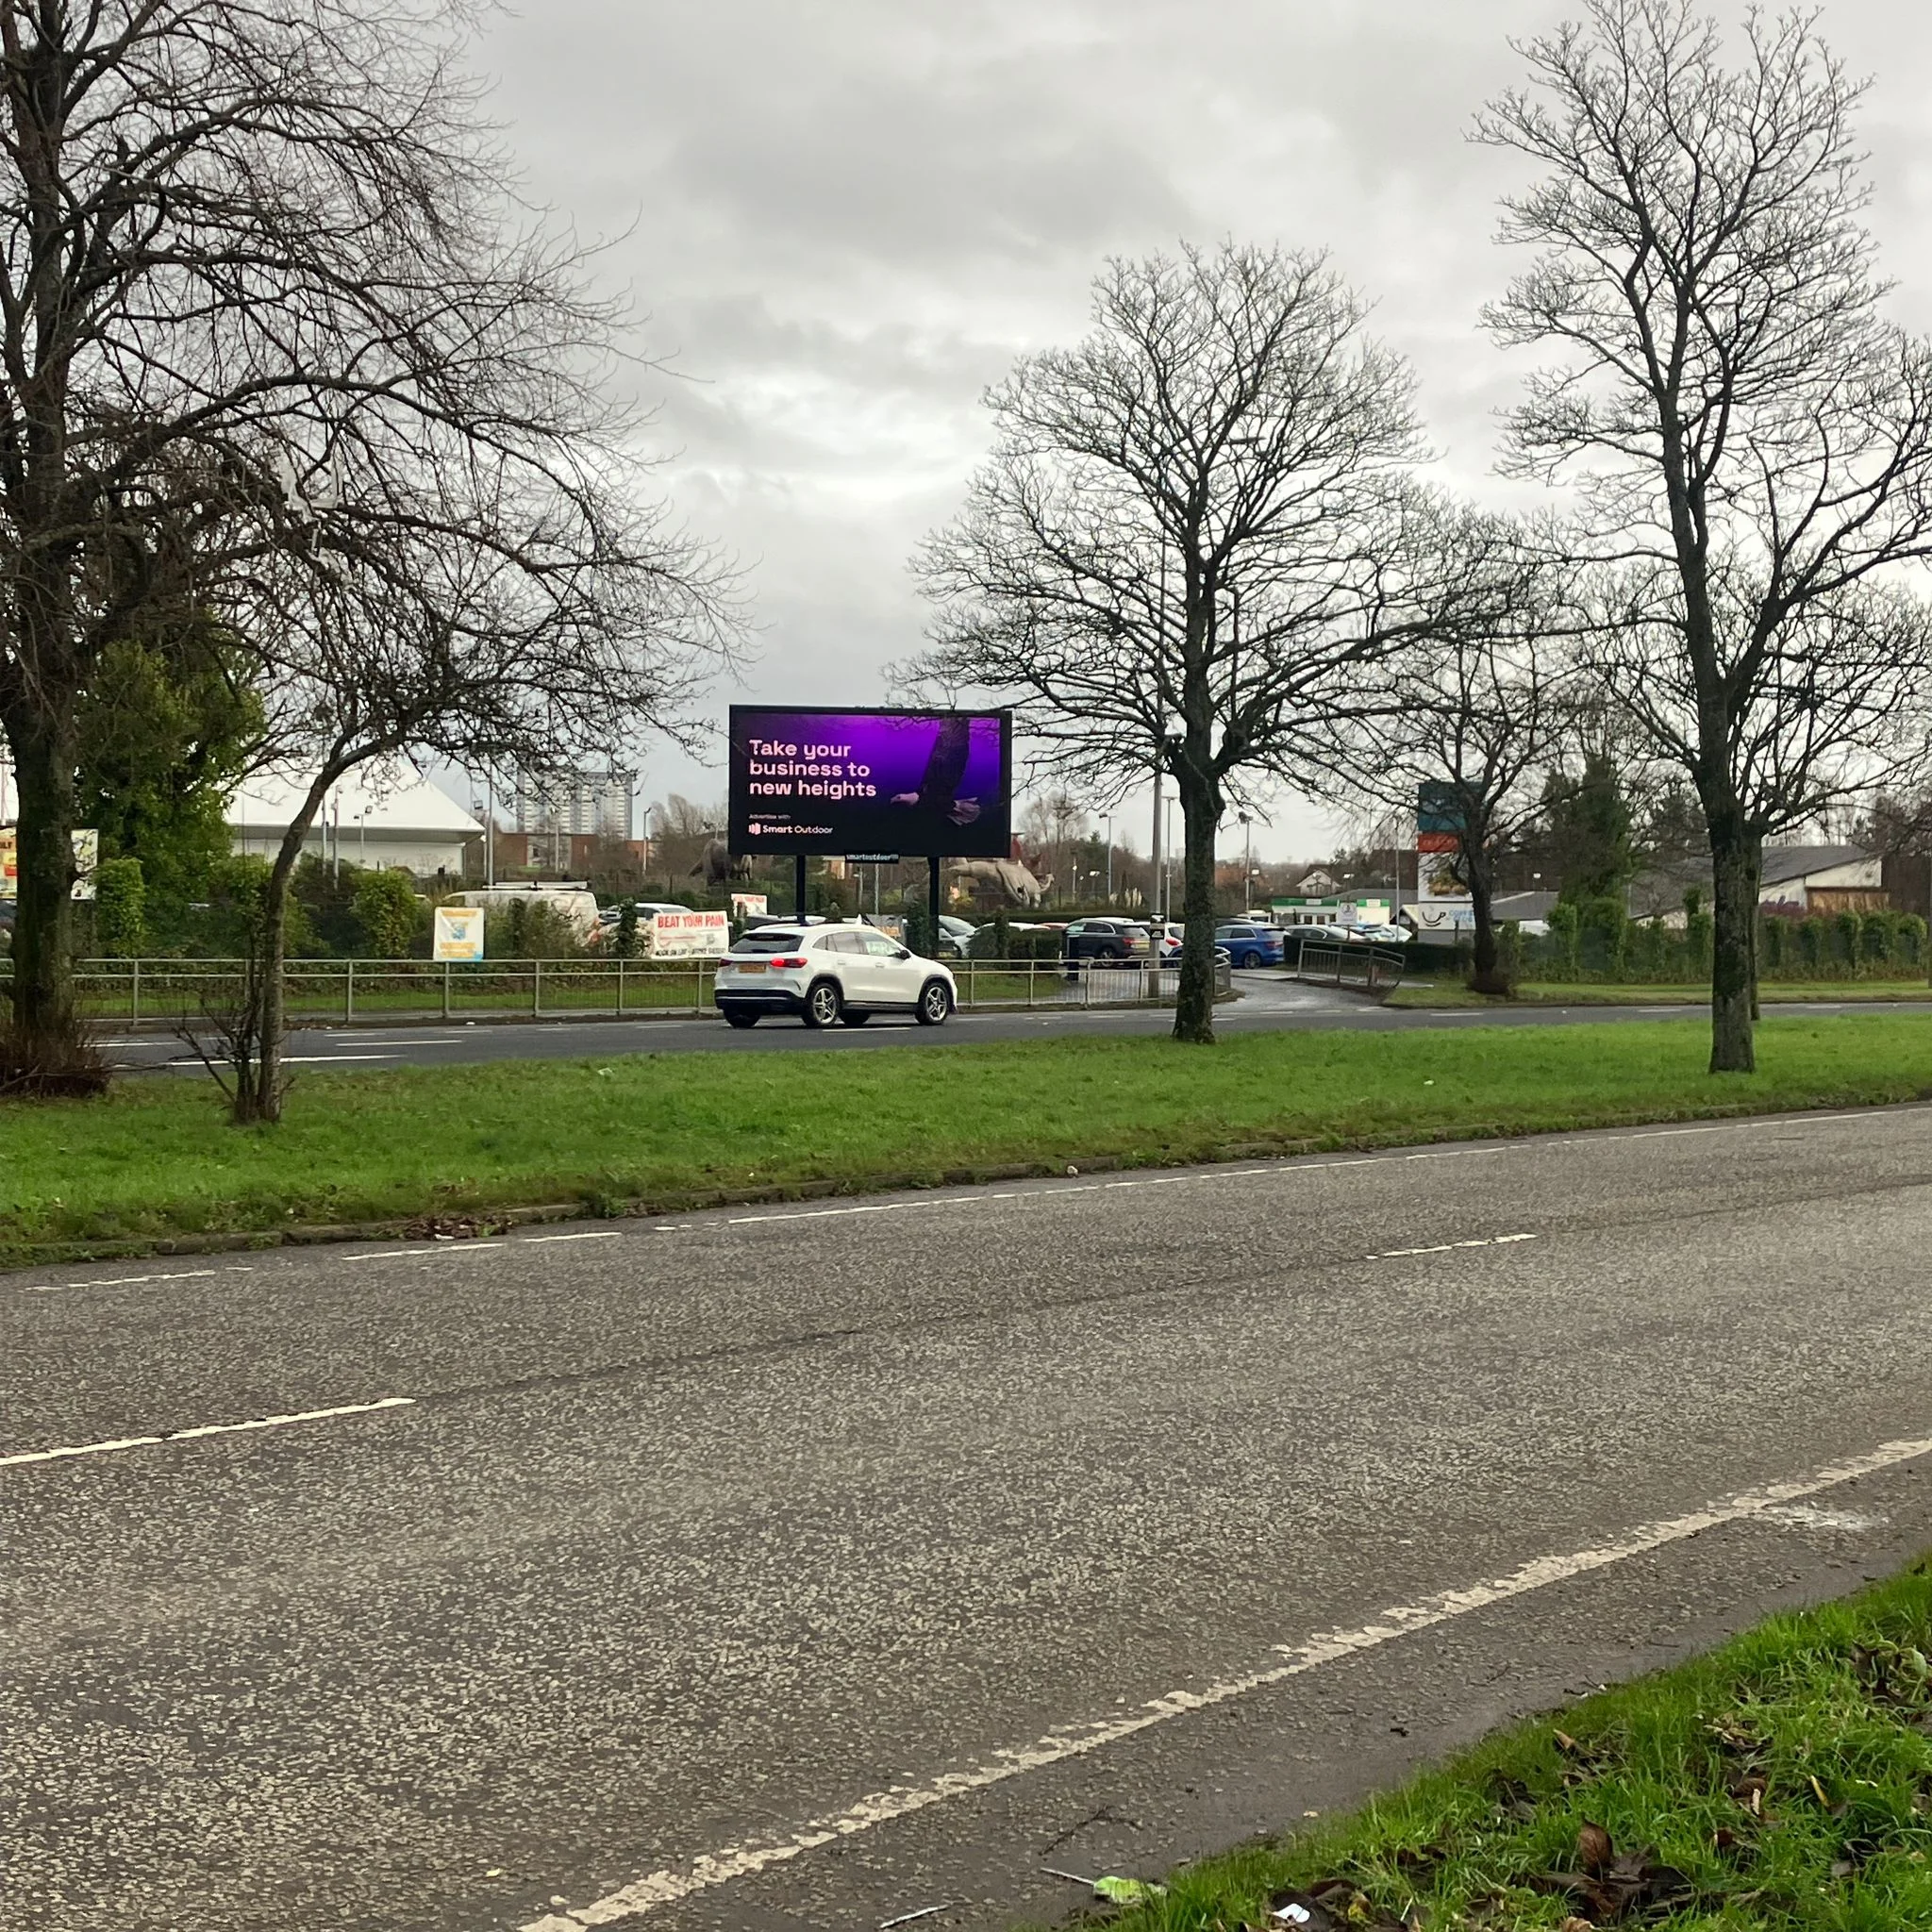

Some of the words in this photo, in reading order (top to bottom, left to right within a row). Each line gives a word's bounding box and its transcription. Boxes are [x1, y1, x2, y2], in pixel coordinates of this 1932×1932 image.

[749, 739, 797, 756] Take
[804, 743, 851, 760] your
[749, 758, 842, 776] business
[847, 762, 871, 776] to
[749, 782, 791, 795] new
[798, 780, 876, 800] heights
[762, 824, 793, 834] Smart
[794, 825, 833, 834] Outdoor
[658, 916, 680, 928] BEAT
[682, 914, 703, 927] YOUR
[706, 914, 724, 927] PAIN
